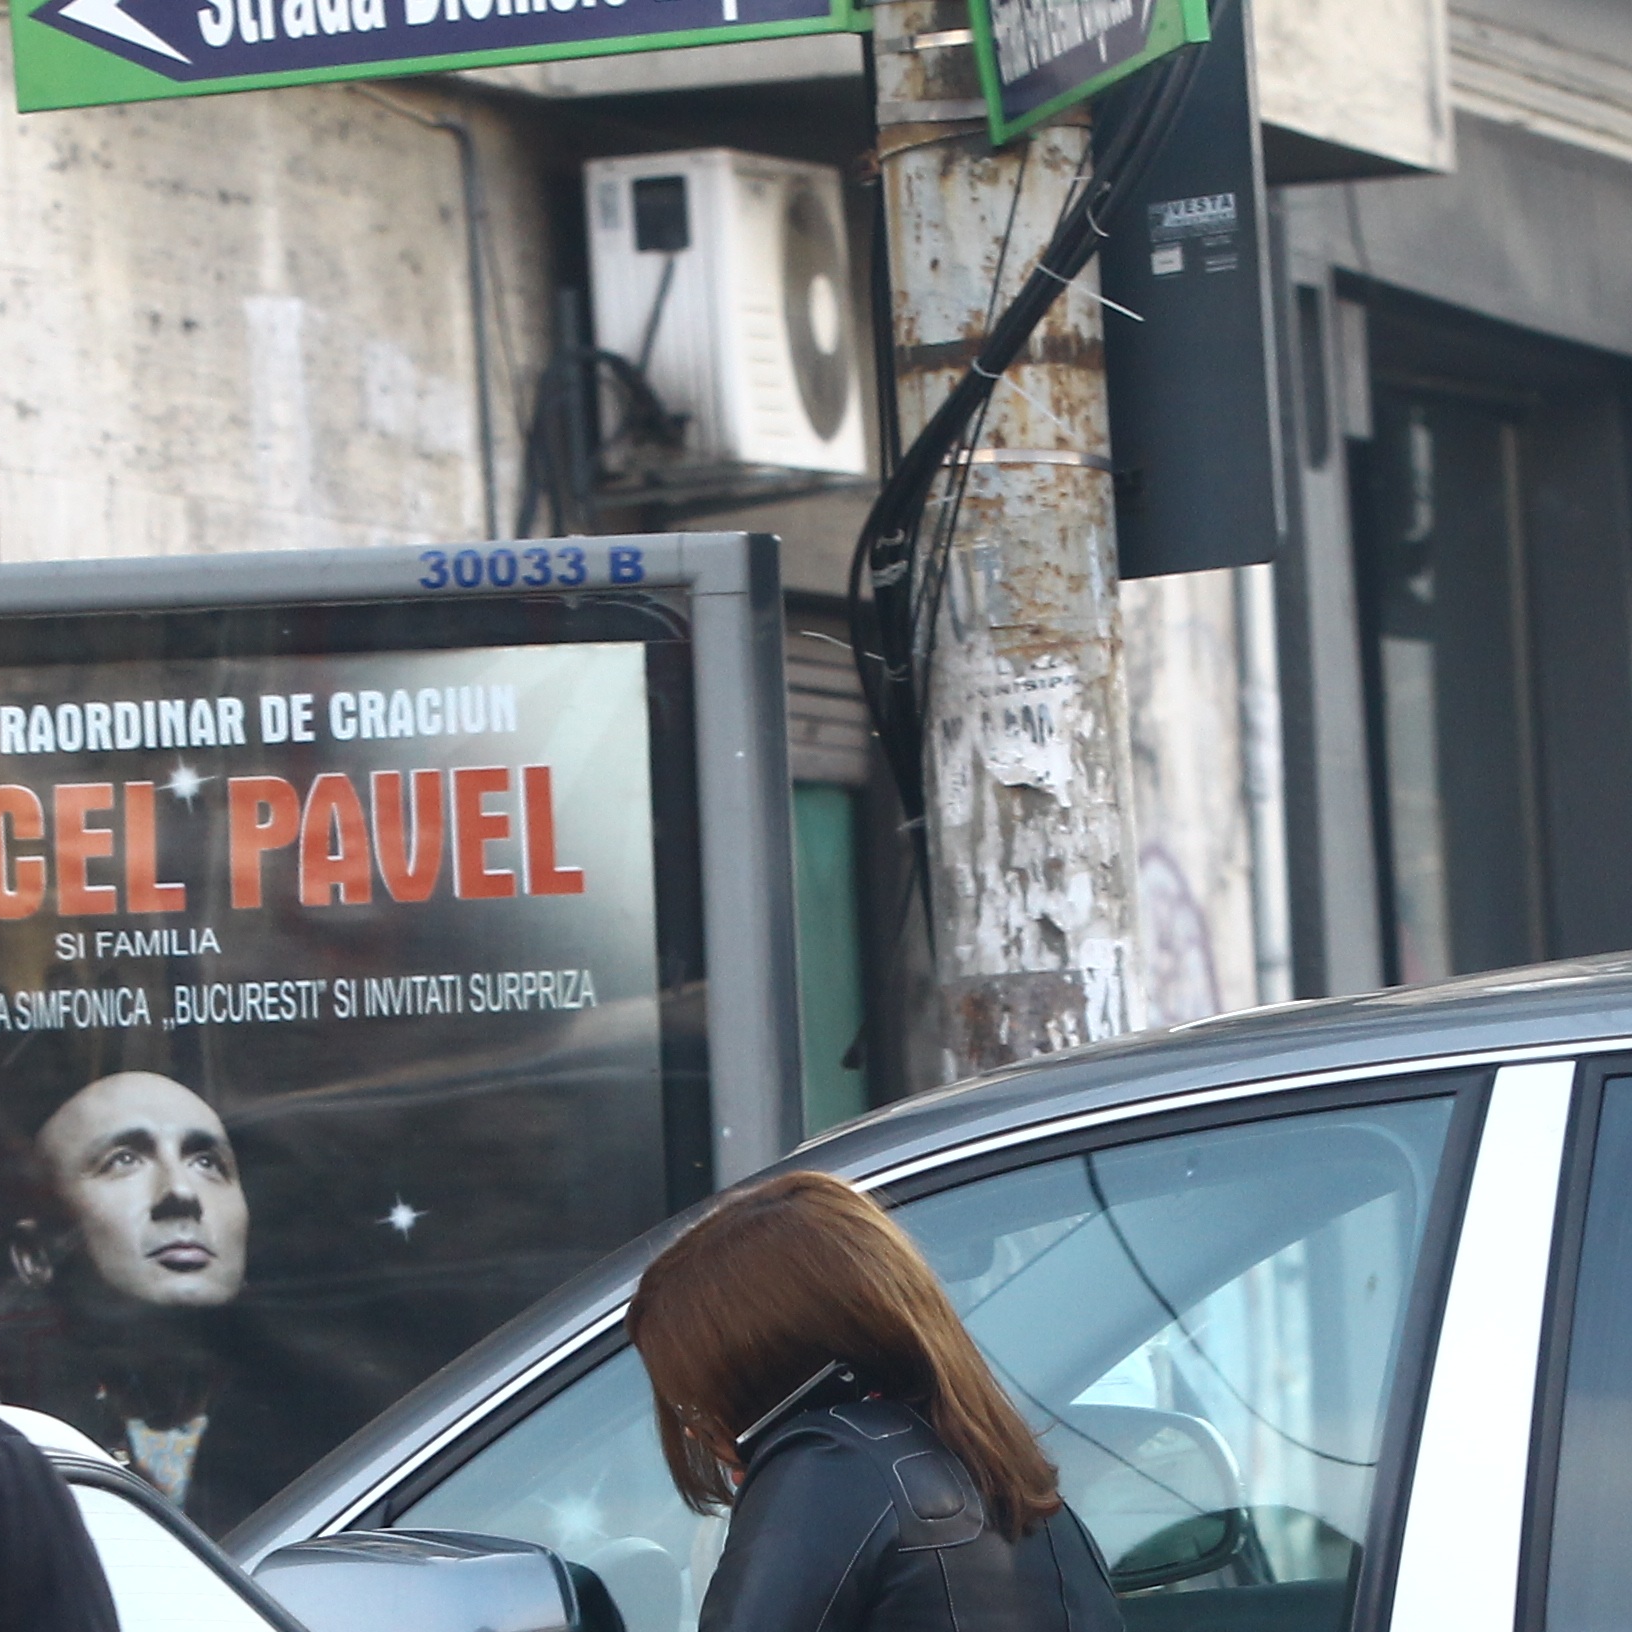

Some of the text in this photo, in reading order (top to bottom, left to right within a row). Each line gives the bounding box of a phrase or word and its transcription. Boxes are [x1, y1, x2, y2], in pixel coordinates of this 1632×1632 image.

[419, 545, 645, 589] 30033 B
[260, 693, 316, 743] DE
[328, 683, 517, 741] CRACIUN
[228, 764, 585, 909] PAVEL
[55, 927, 221, 960] SI FAMILIA
[15, 987, 151, 1031] SIMFONICA
[333, 978, 357, 1018] SI
[364, 974, 462, 1017] INVITATI
[469, 969, 597, 1012] SURPRIZA
